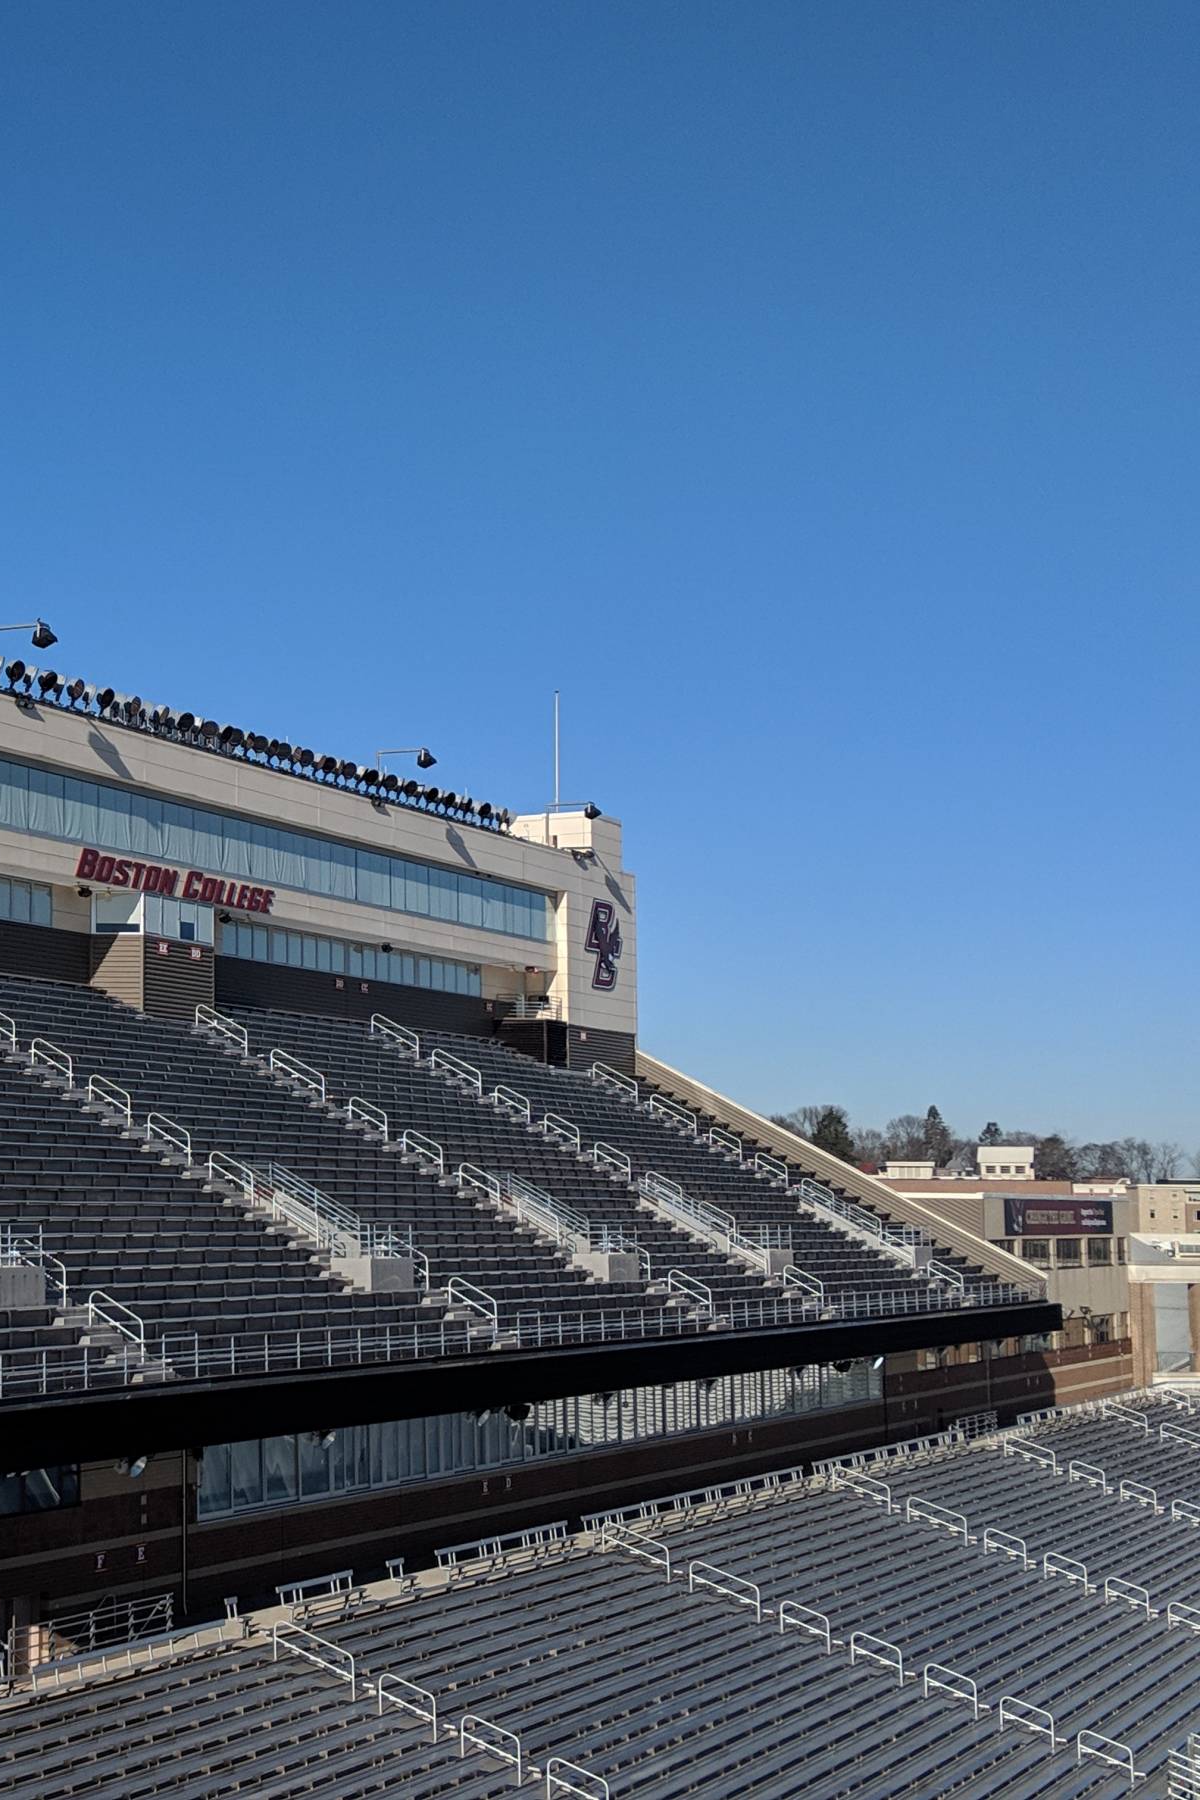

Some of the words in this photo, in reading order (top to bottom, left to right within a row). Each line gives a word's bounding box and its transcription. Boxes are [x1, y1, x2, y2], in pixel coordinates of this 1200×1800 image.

[76, 847, 179, 898] BOSTON
[182, 870, 276, 914] COLLEGE
[137, 1546, 145, 1561] E
[97, 1554, 105, 1569] F
